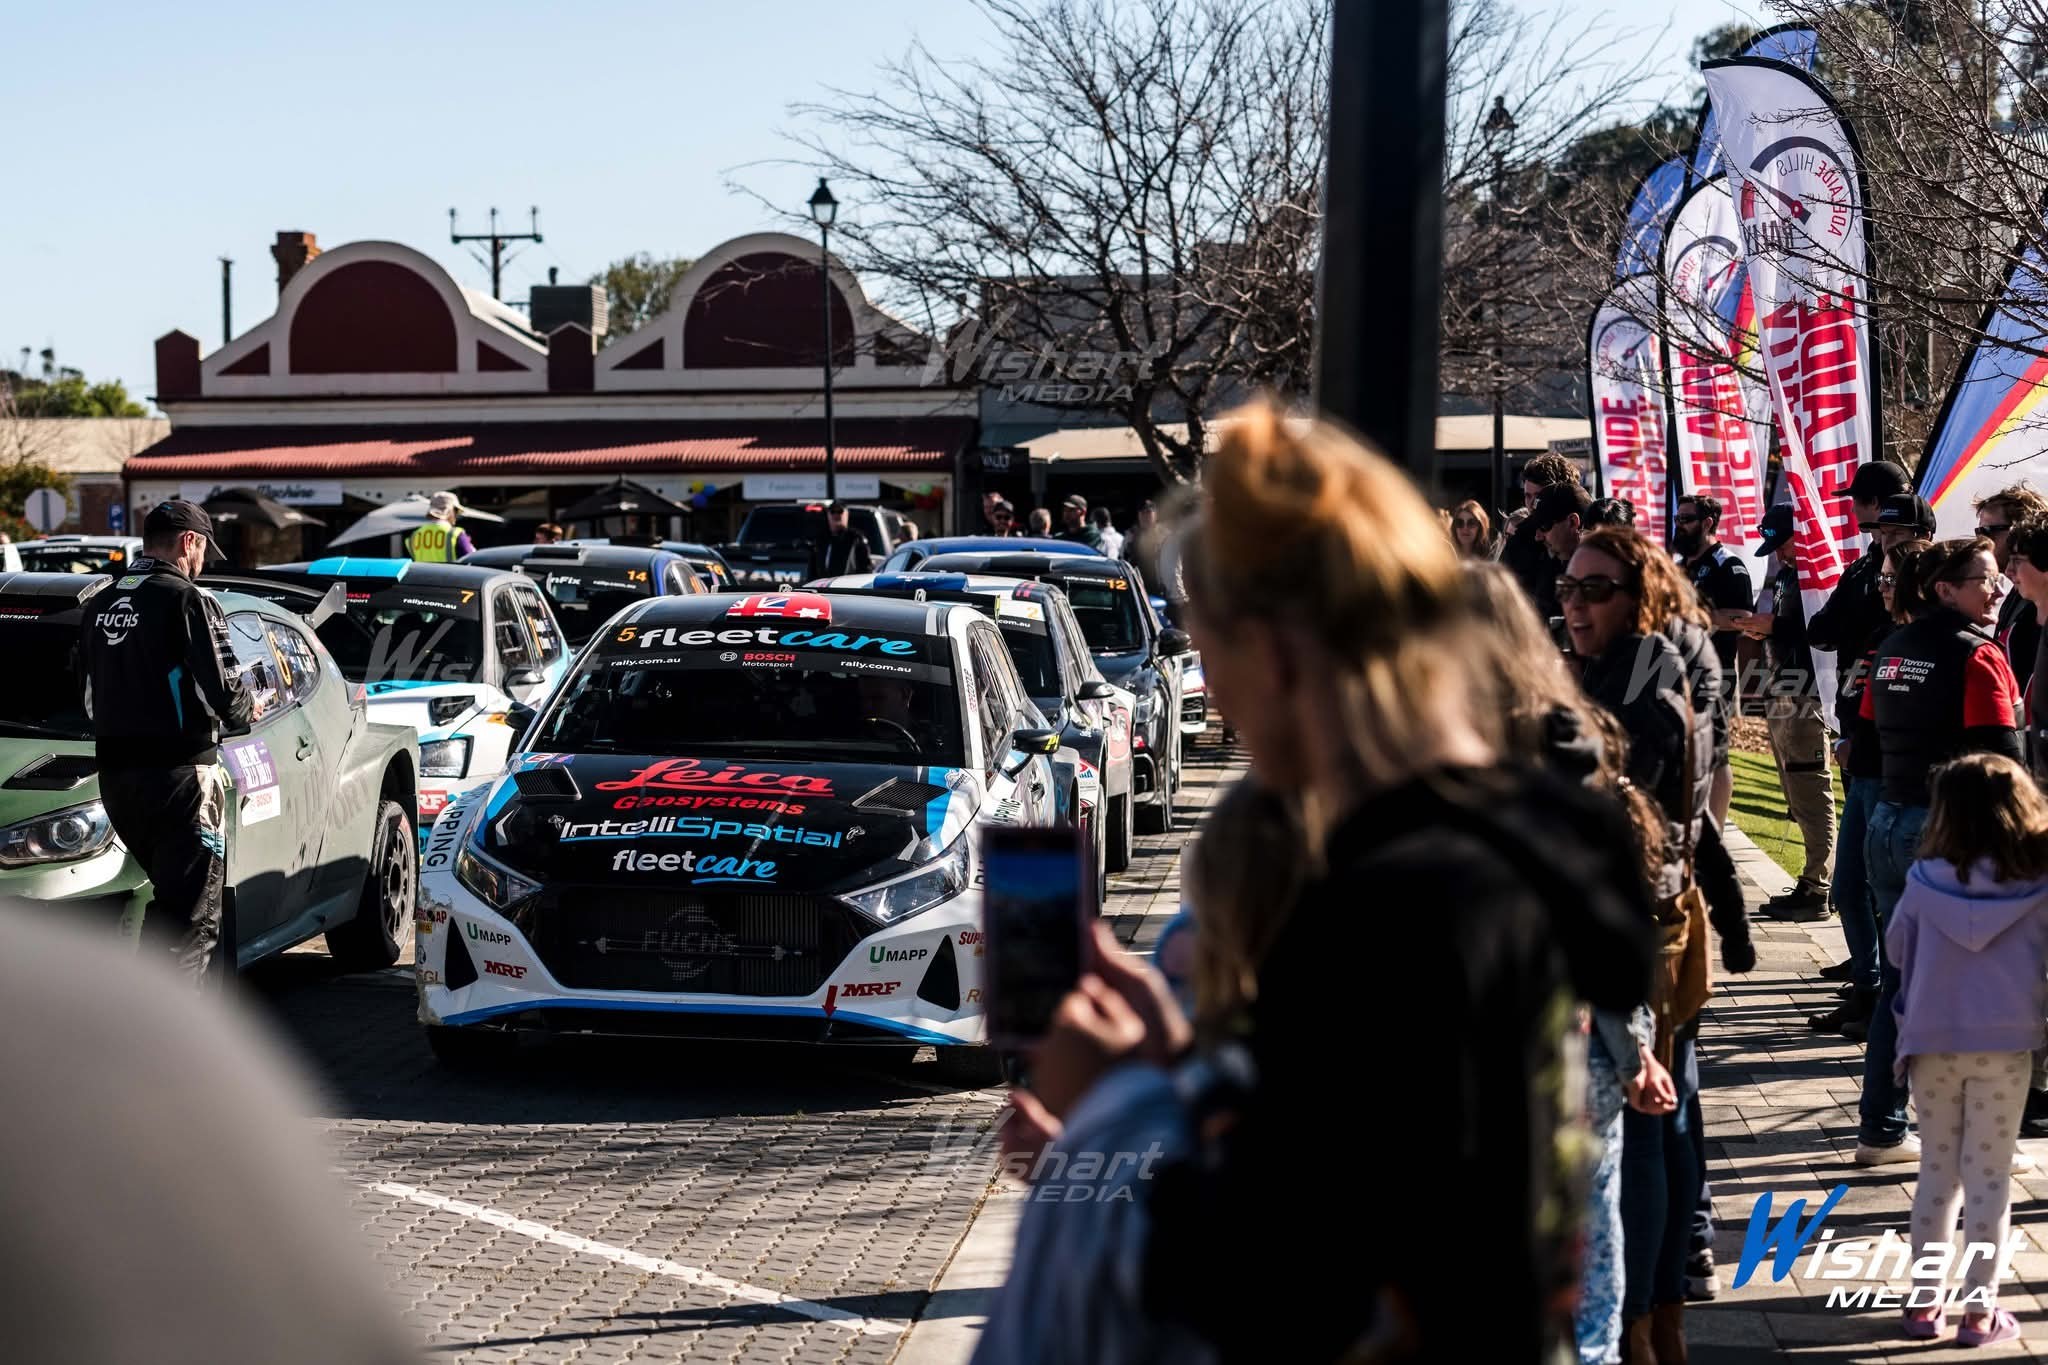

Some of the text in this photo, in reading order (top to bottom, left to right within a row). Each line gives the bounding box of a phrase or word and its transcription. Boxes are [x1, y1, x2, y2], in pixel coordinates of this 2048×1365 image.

[627, 570, 648, 582] 14
[1106, 578, 1128, 590] 12
[403, 597, 457, 610] rally.com.au
[460, 590, 475, 604] 7
[96, 613, 139, 627] FUCHS
[617, 627, 917, 655] 5 fleetcare
[611, 656, 681, 667] rally.com.au
[743, 652, 795, 662] BOSCH
[1903, 659, 1935, 669] TOYOTA
[840, 660, 911, 673] rally.com.au
[1899, 666, 1929, 675] GAZOO
[595, 758, 835, 798] Leica
[420, 793, 447, 809] RF
[614, 795, 806, 815] Geosystems
[560, 816, 842, 848] IntelliSpatial
[612, 849, 779, 880] fleetcare
[466, 922, 511, 945] UMAPP
[869, 946, 928, 964] UMAPP
[484, 960, 527, 978] MRF
[841, 981, 901, 997] MRF
